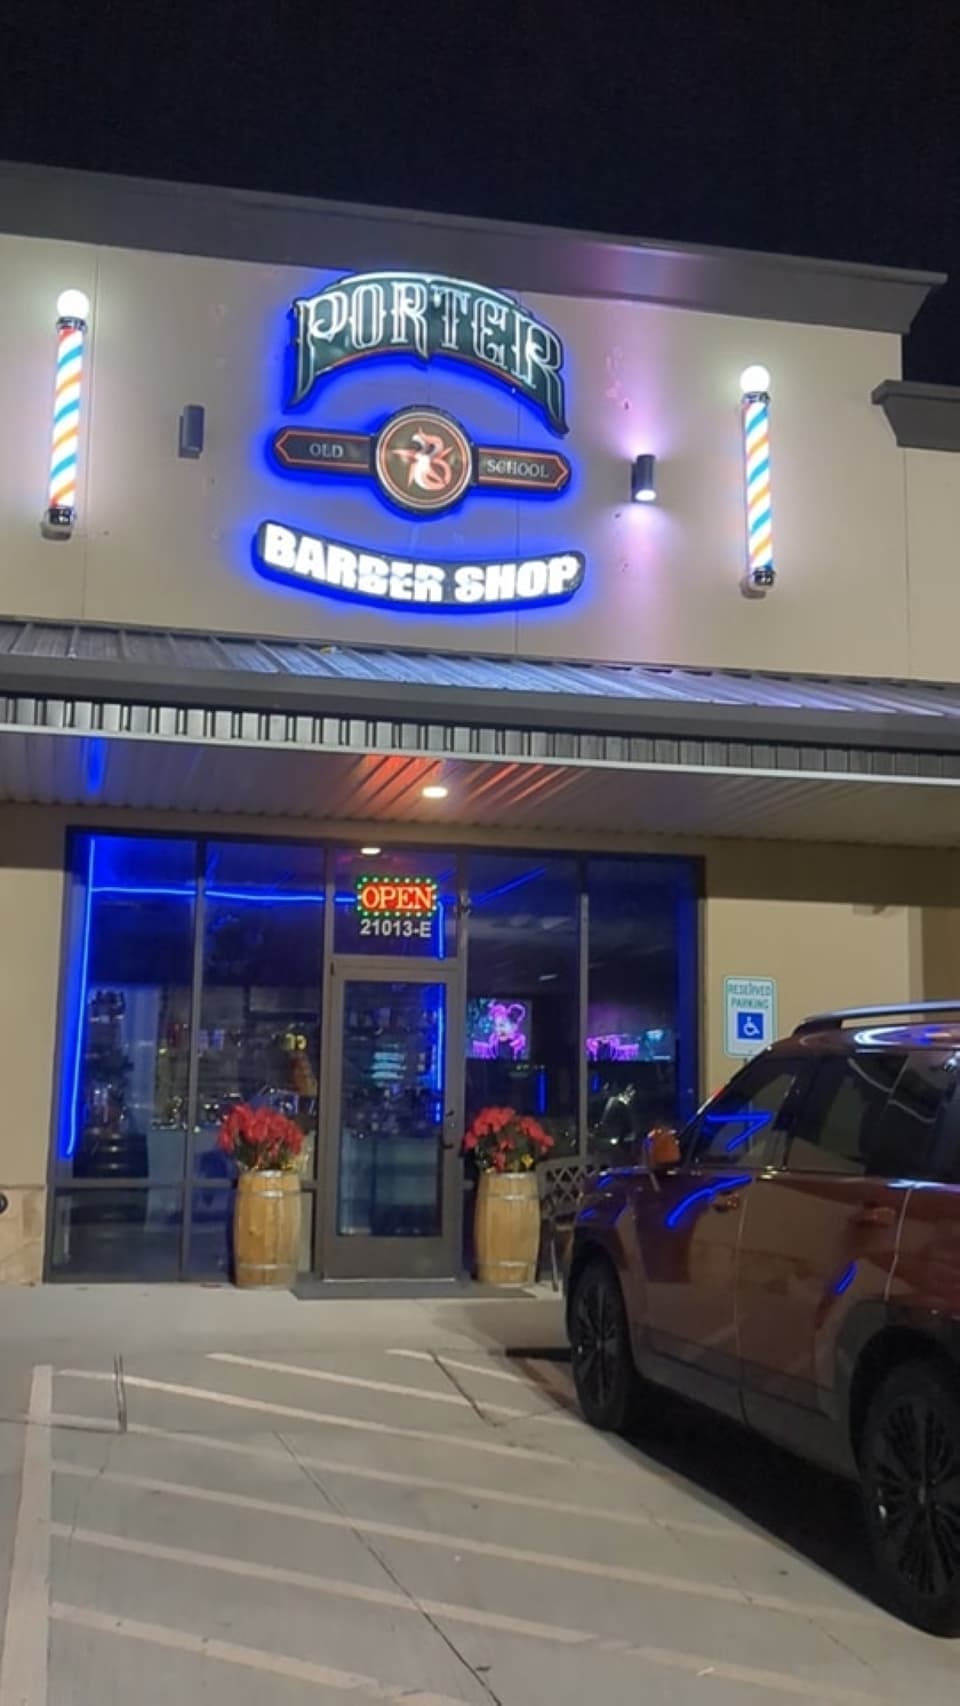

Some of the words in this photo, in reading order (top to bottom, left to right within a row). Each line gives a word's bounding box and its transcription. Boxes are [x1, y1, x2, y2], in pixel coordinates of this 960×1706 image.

[291, 280, 567, 431] PORTER
[309, 443, 344, 458] OLD
[487, 459, 549, 478] SCHOOL
[263, 522, 446, 603] BARBER
[454, 556, 580, 603] SHOP
[361, 885, 432, 910] OPEN
[360, 919, 432, 938] 21013-E
[727, 983, 771, 996] RESERVED
[731, 997, 769, 1009] PARKING
